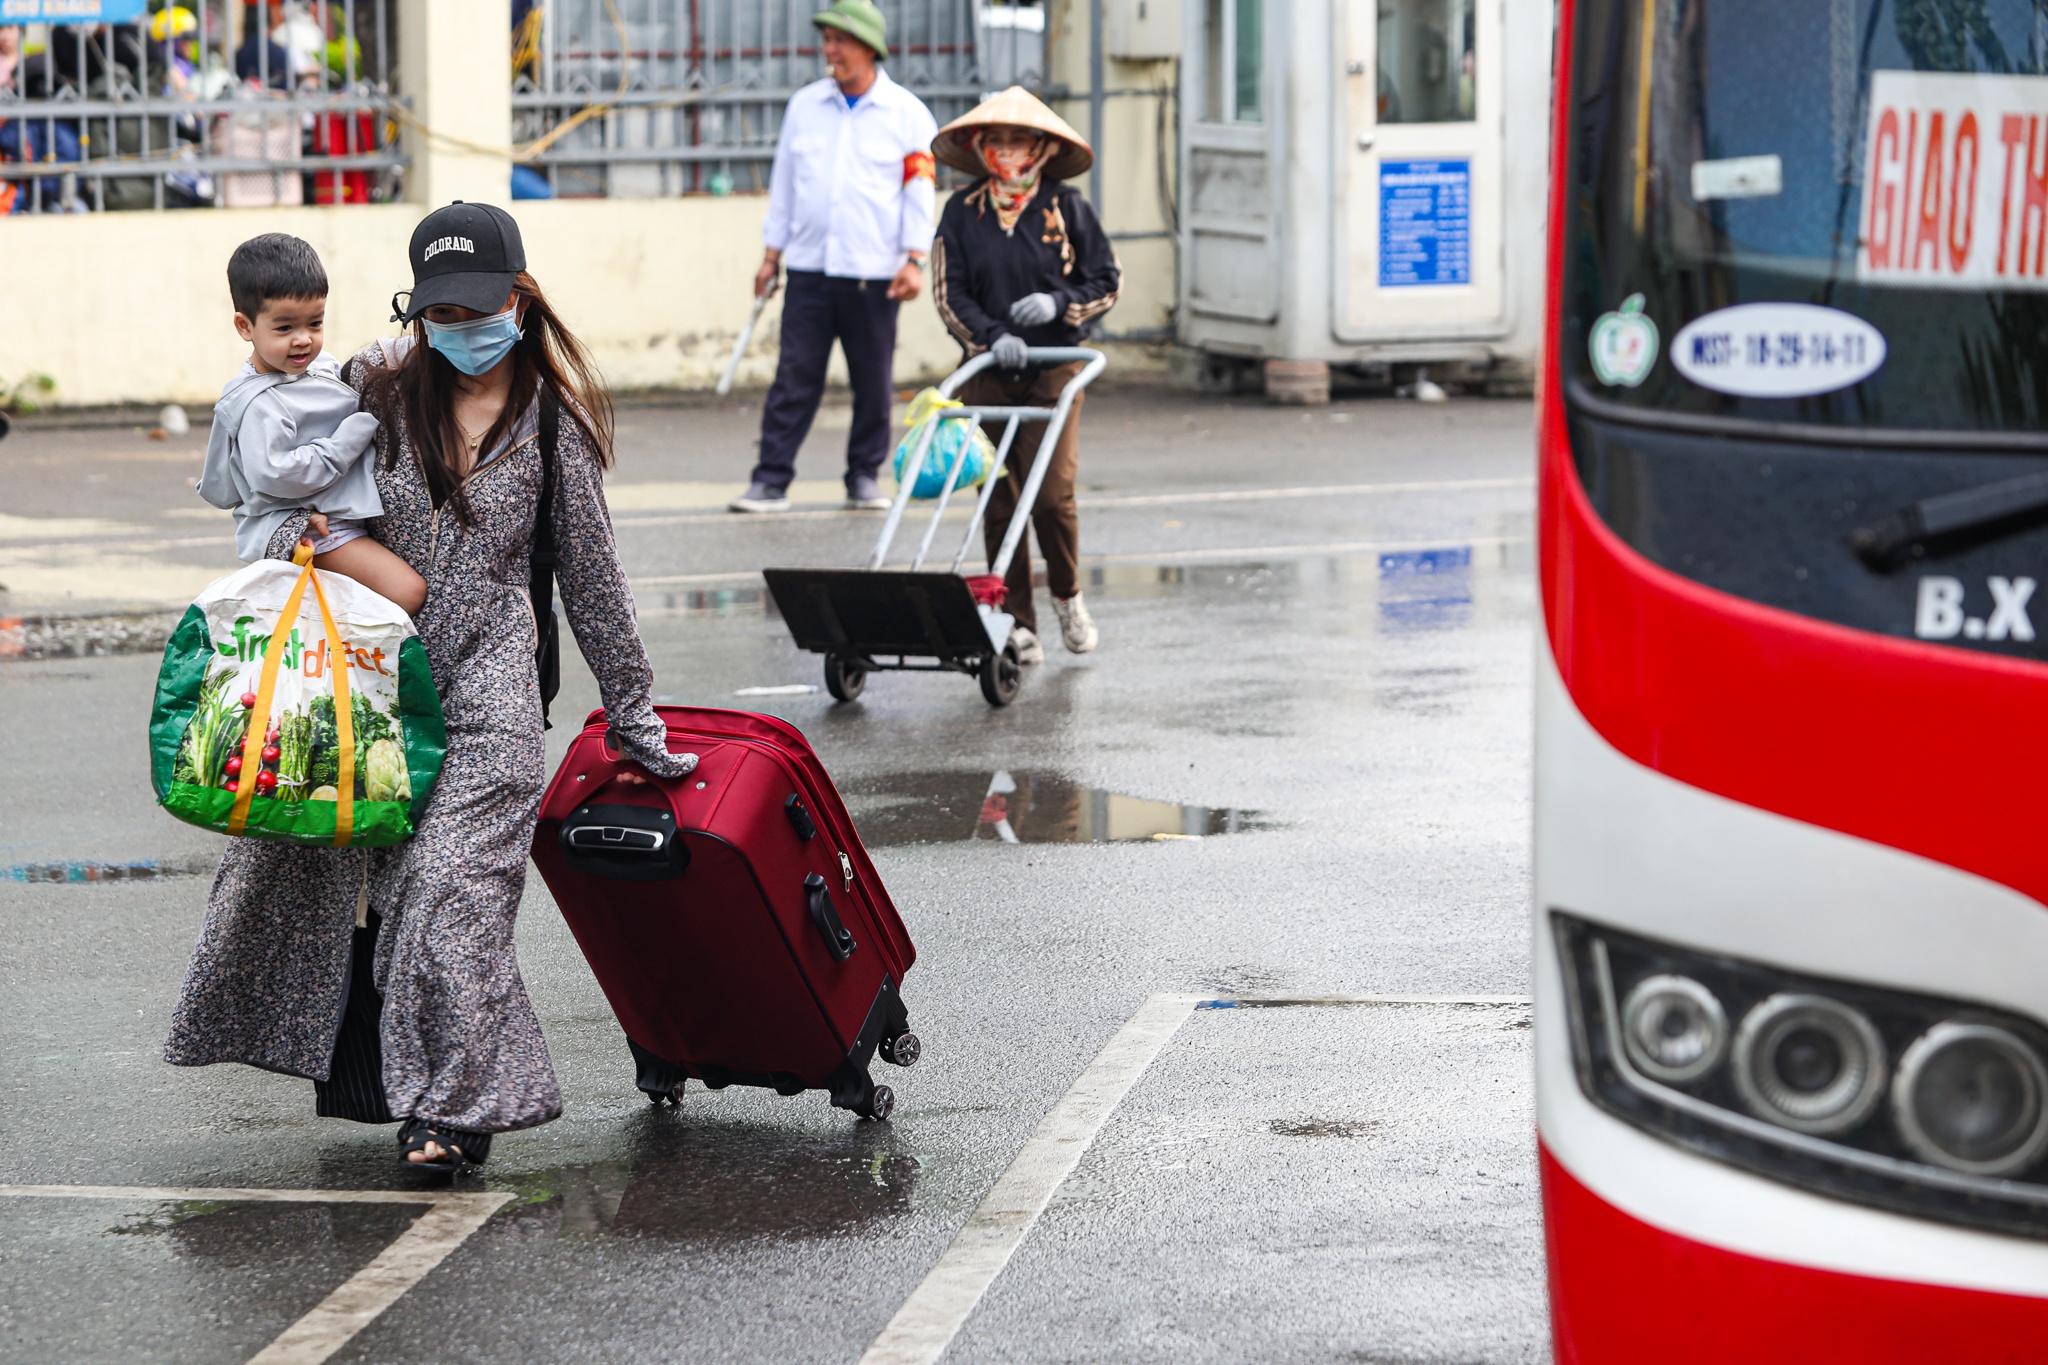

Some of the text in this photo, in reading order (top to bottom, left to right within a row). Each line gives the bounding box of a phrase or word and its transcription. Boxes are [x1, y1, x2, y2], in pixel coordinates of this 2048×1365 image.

[1868, 106, 1978, 273] GIAO
[424, 236, 474, 261] COLORADO
[1914, 575, 2037, 642] B.X
